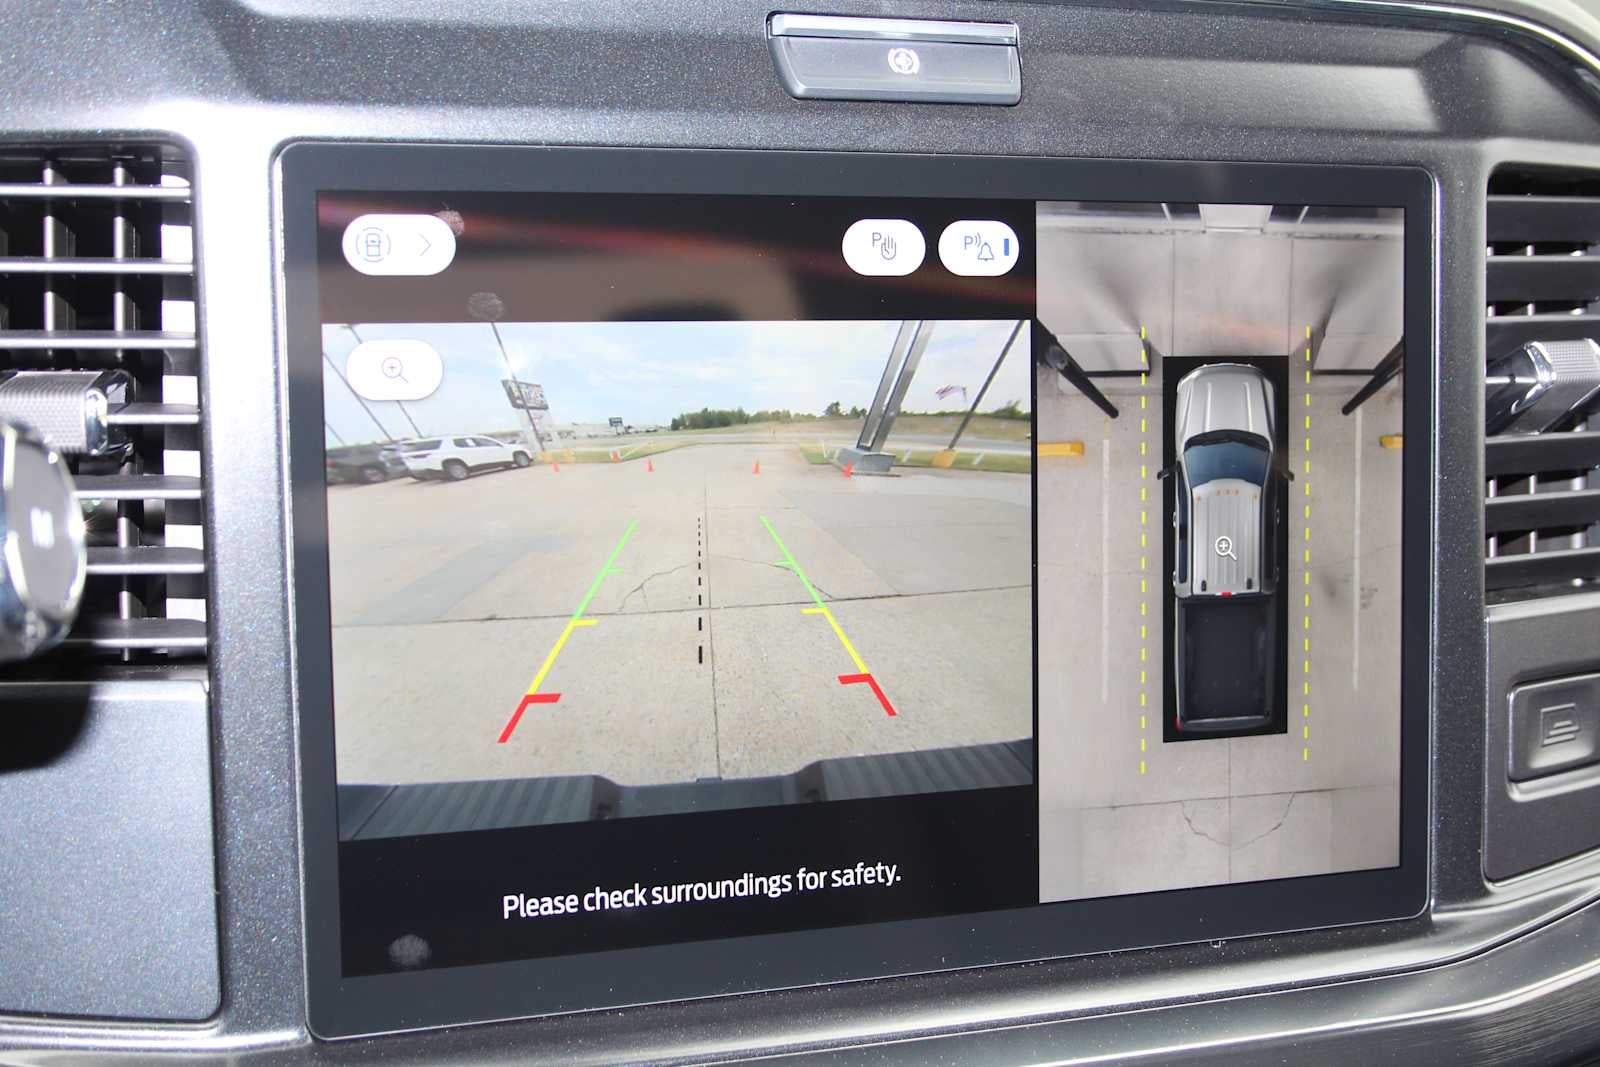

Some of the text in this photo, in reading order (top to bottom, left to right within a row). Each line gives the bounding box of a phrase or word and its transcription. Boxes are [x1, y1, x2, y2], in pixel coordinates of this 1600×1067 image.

[872, 232, 882, 247] P
[964, 235, 974, 250] P
[503, 861, 902, 920] Please check surroundings for safety.
